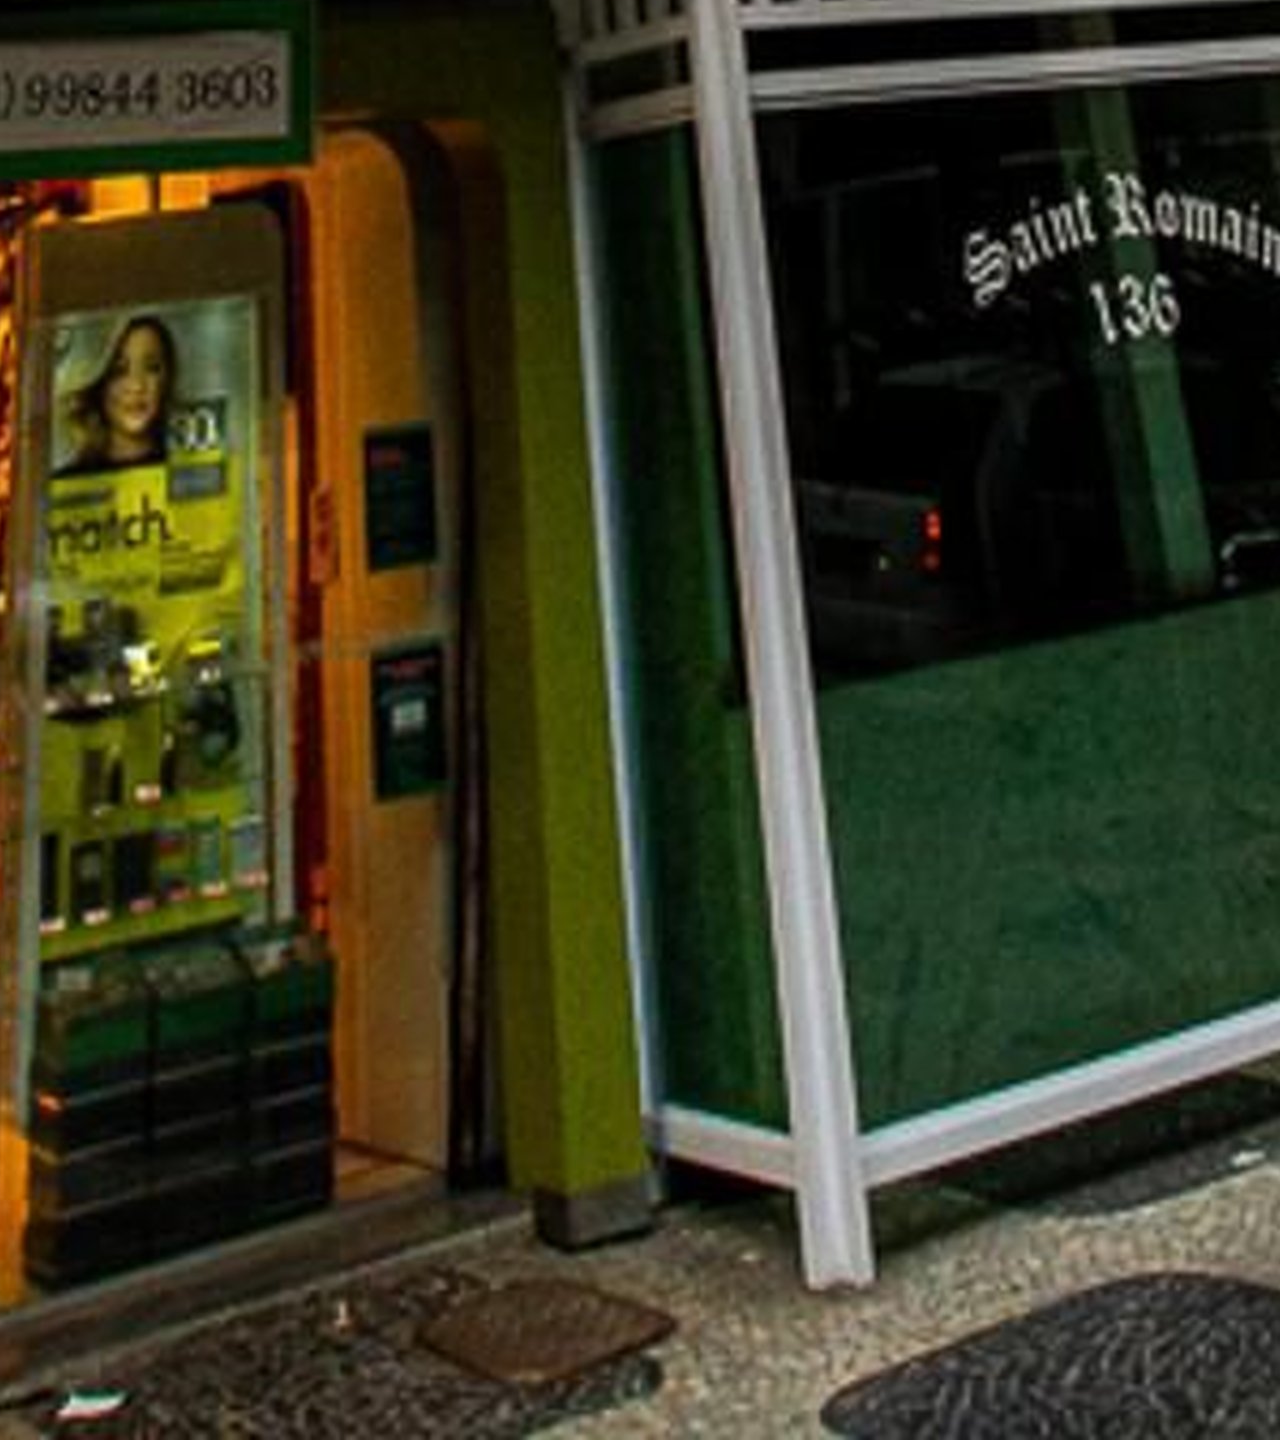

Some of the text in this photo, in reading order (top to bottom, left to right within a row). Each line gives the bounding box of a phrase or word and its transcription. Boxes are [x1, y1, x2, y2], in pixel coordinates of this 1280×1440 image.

[175, 64, 278, 114] 3603
[962, 190, 1100, 306] Saint
[1088, 272, 1181, 345] 136
